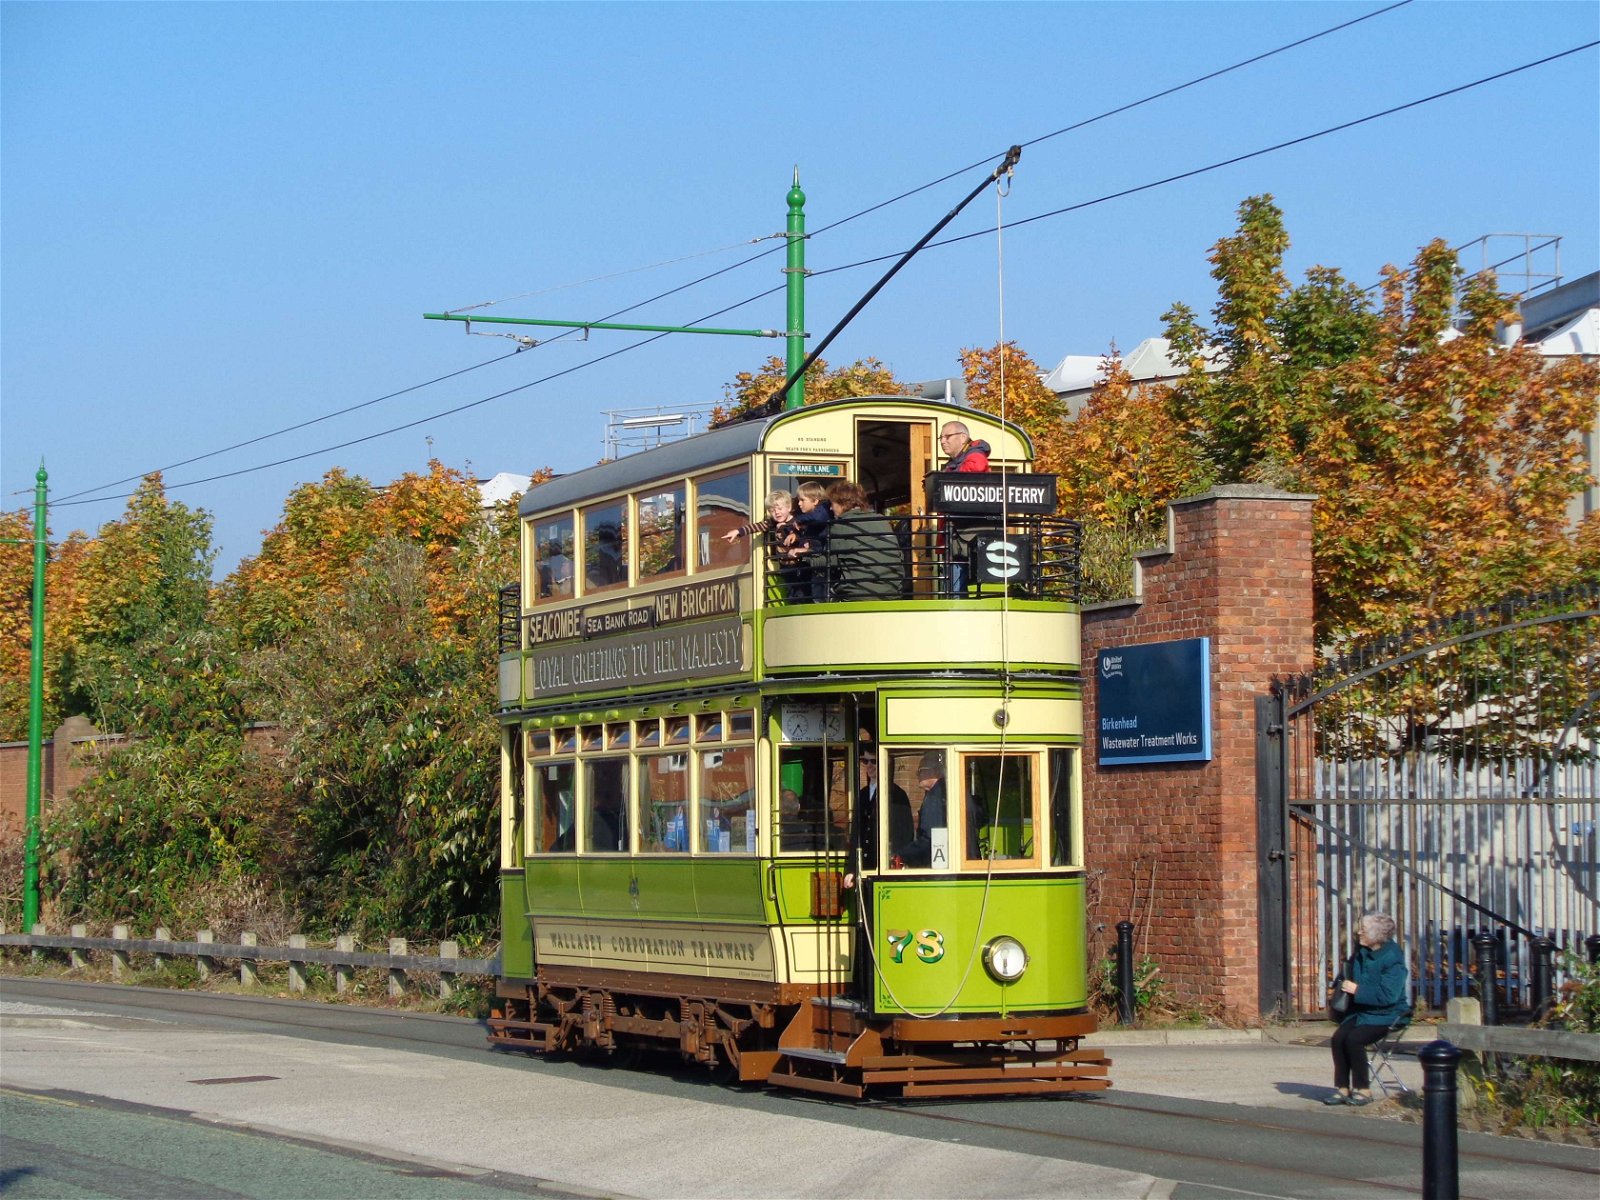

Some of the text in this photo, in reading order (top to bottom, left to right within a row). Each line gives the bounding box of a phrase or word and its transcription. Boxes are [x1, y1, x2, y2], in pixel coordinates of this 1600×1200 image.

[814, 465, 830, 473] LANE
[943, 485, 1045, 504] WOODSIDE FERRY
[986, 541, 1020, 578] S
[656, 582, 735, 622] NEW BRIGHTON
[529, 608, 581, 643] SEACOMBE
[587, 609, 649, 633] SEA BANK ROAD
[534, 626, 741, 690] LOYAL GREETINGS TO HER MAJESTY
[1102, 715, 1137, 730] Birkenhead
[1102, 731, 1197, 749] Wastewater Treatment Works
[932, 848, 946, 863] A
[549, 931, 754, 961] WALLASEY CORPORATION TRAMWAYS
[886, 928, 945, 964] 78
